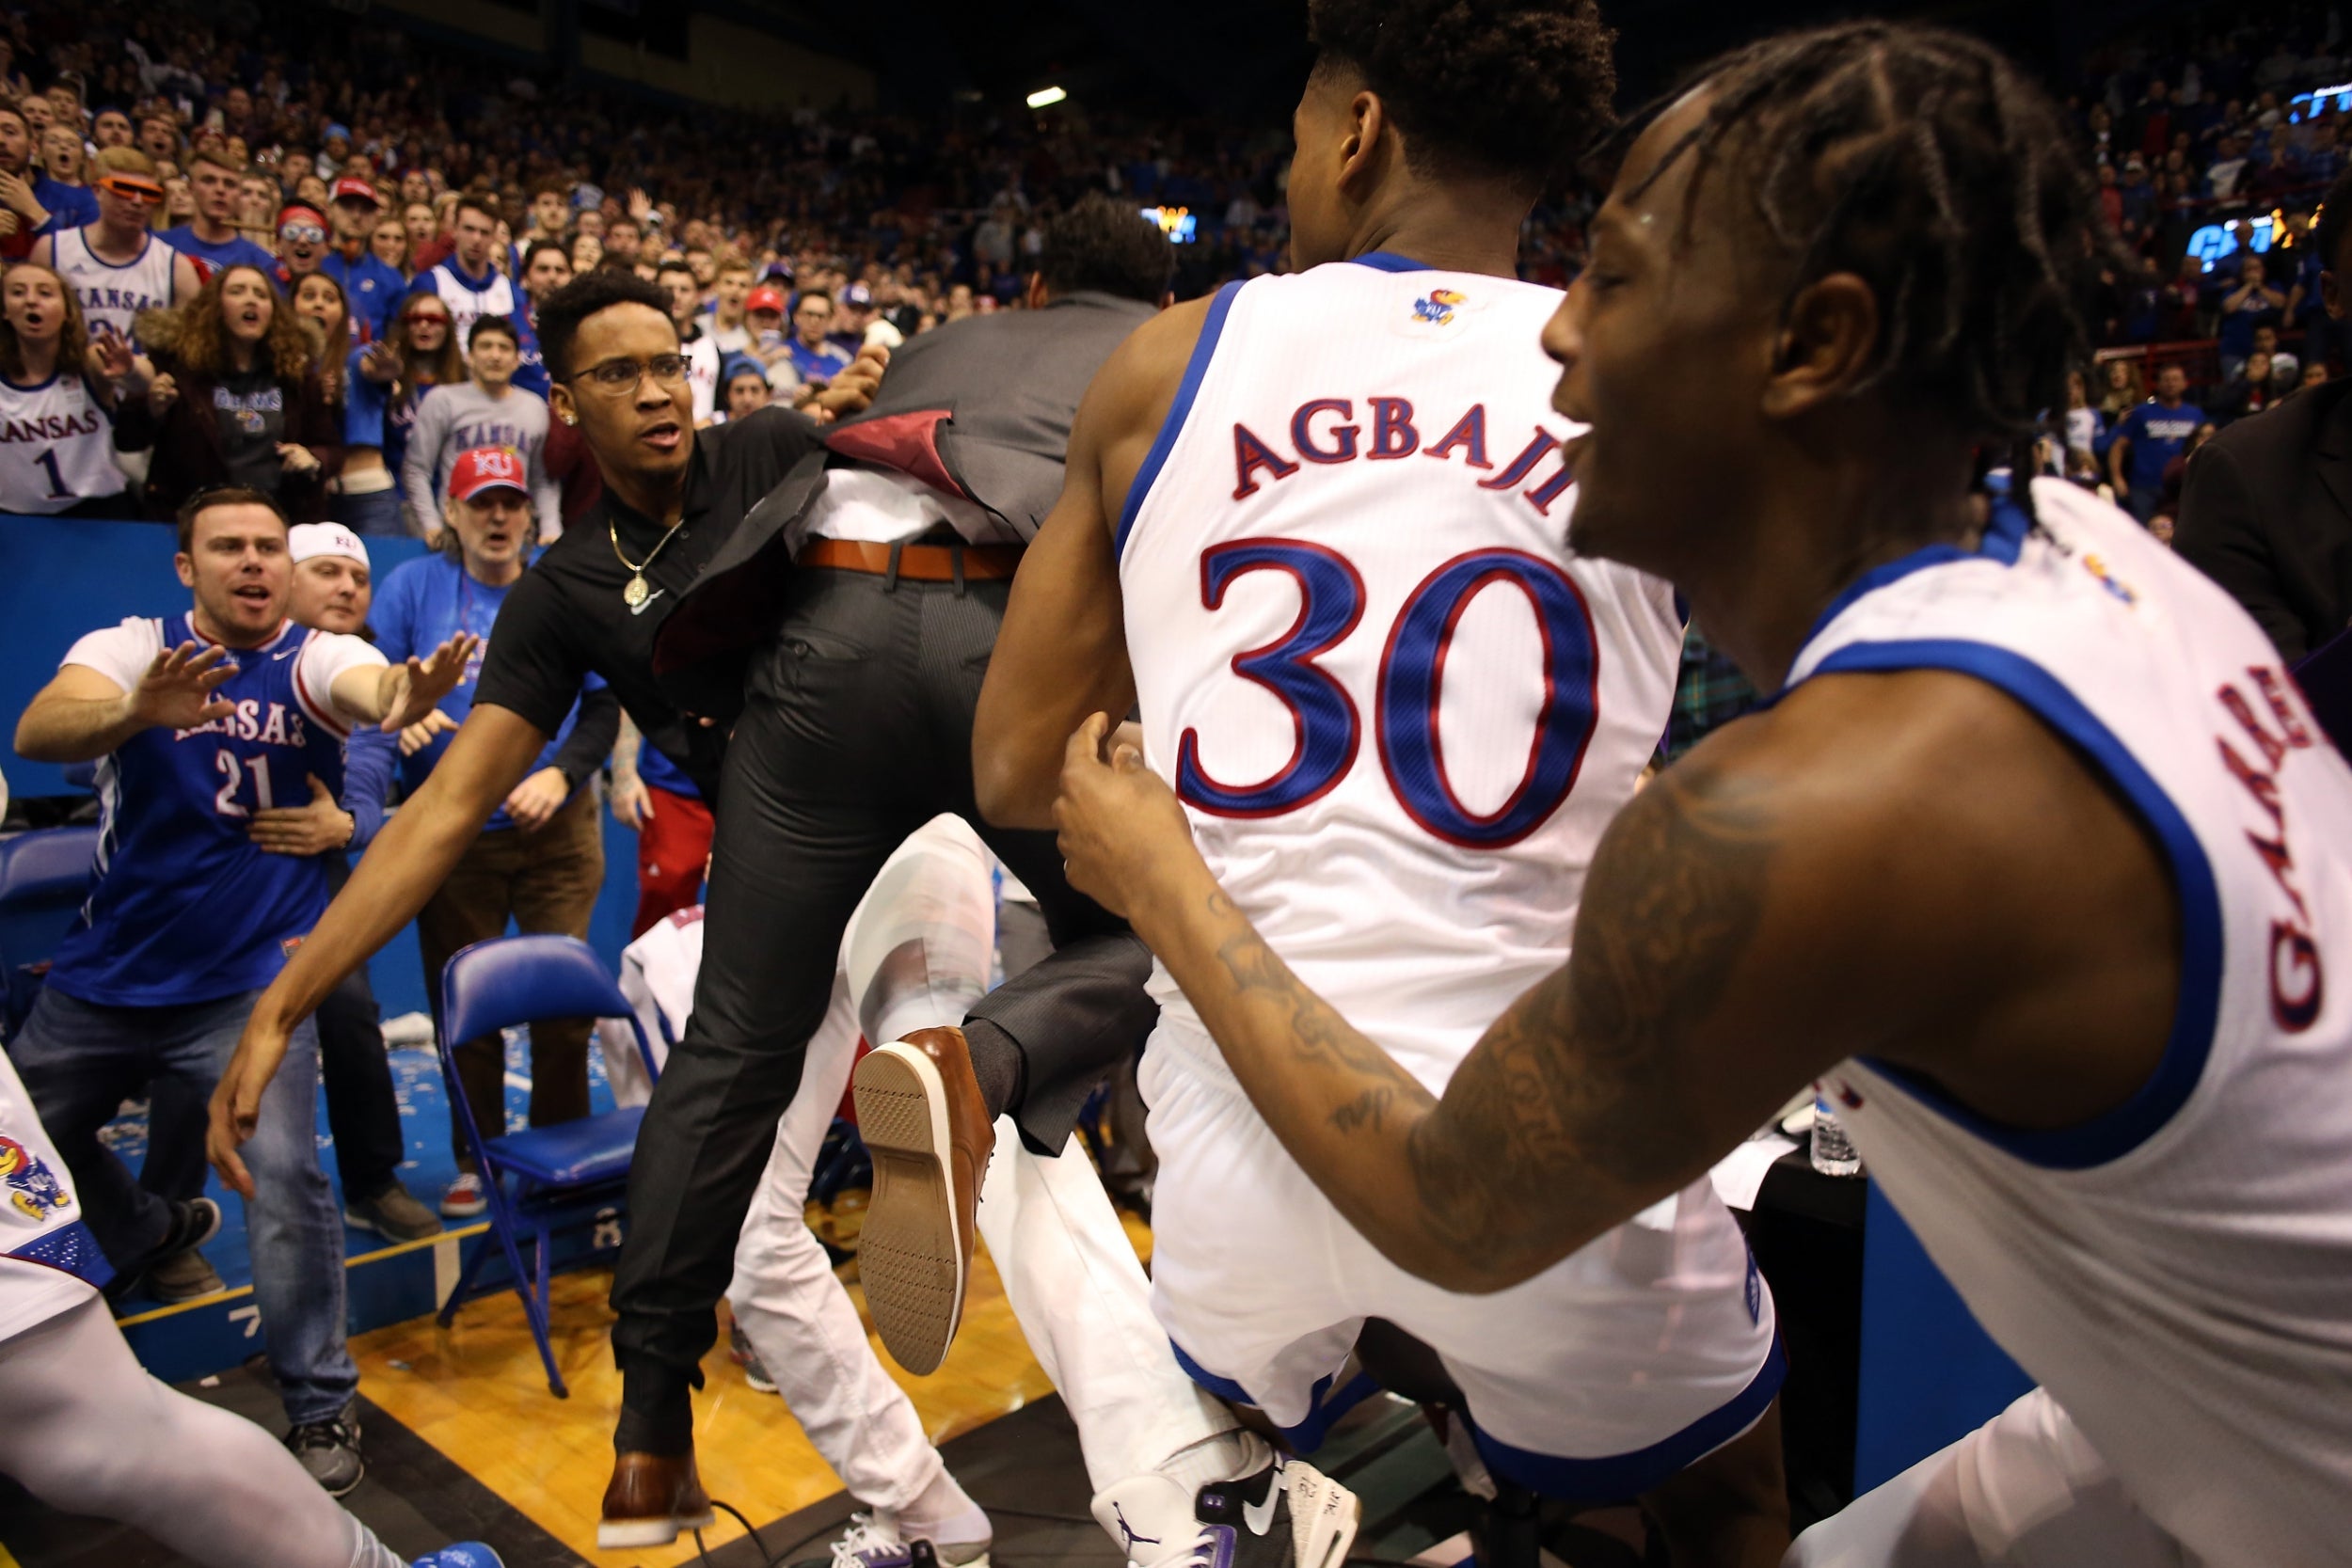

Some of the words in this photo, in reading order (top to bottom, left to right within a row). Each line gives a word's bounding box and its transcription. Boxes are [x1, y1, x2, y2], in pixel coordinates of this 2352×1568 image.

[0, 409, 99, 444] ANSAS
[456, 421, 532, 453] KANSA
[33, 447, 77, 499] 1
[473, 451, 514, 477] KU
[1232, 396, 1575, 517] AGBAJI
[175, 691, 307, 749] SAS
[1175, 536, 1600, 851] 30
[215, 748, 274, 818] 21
